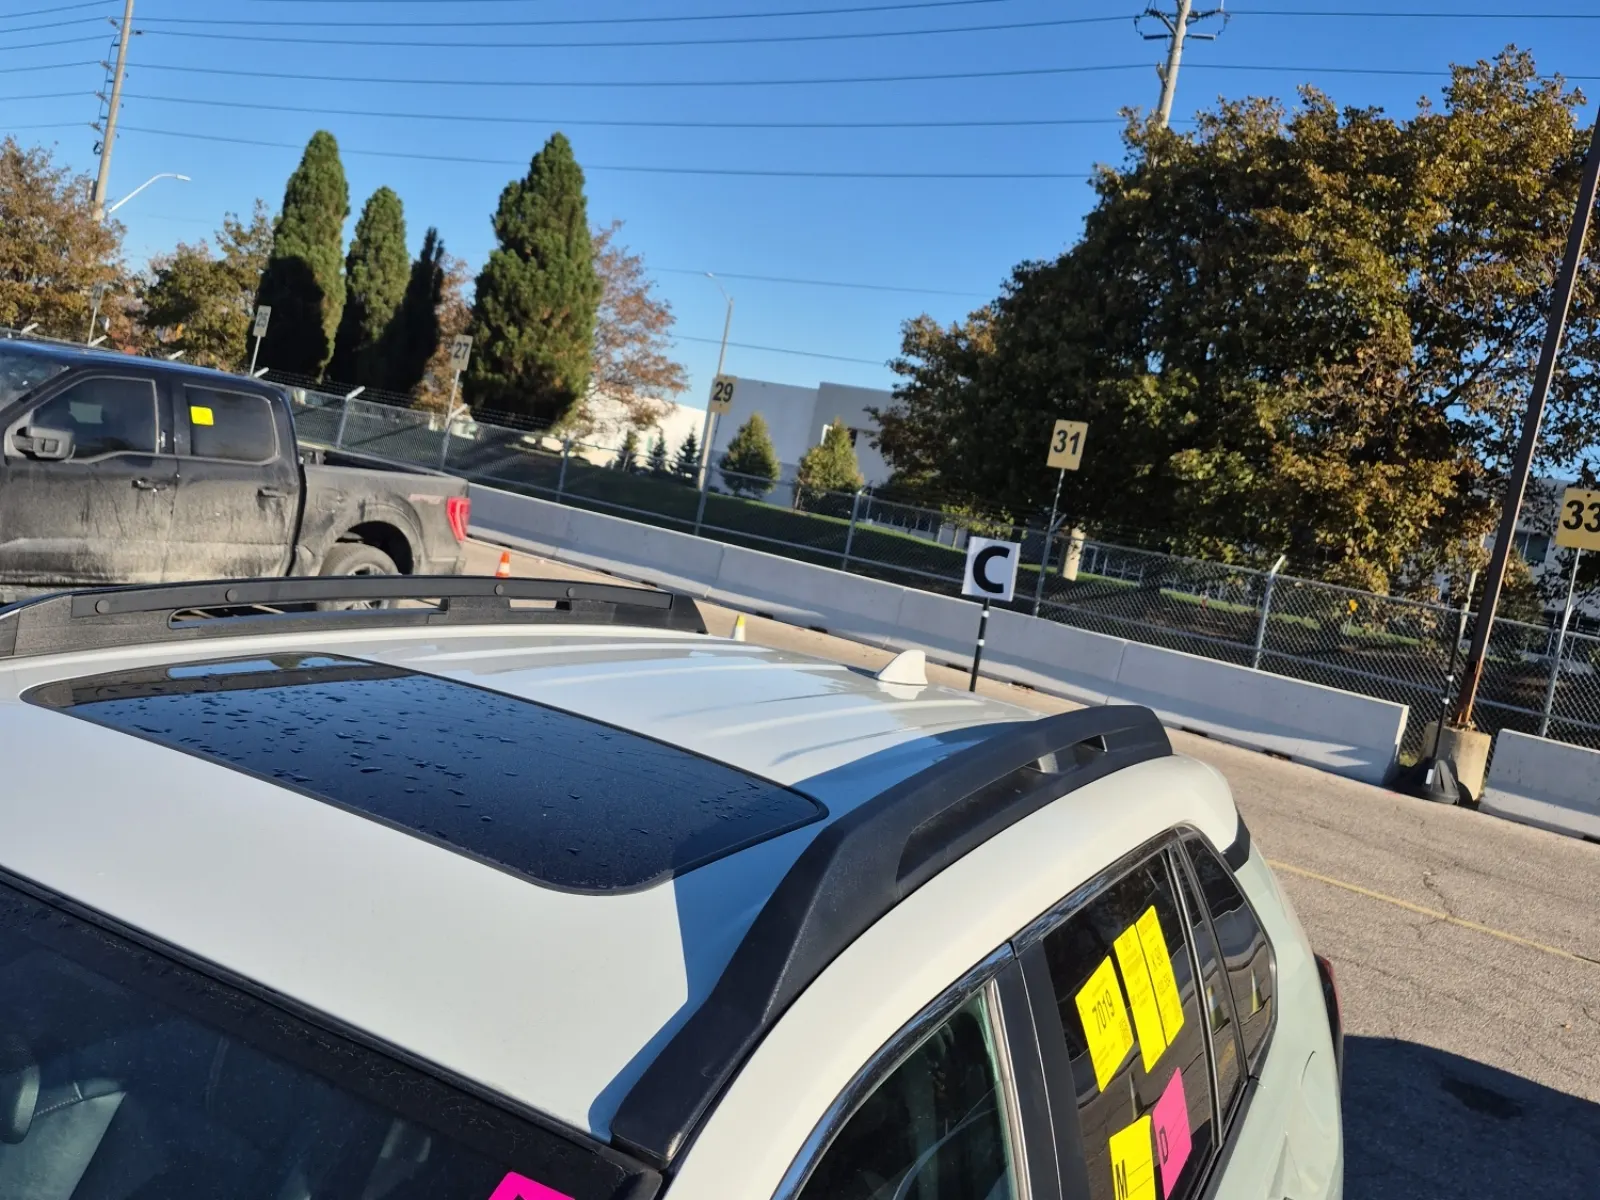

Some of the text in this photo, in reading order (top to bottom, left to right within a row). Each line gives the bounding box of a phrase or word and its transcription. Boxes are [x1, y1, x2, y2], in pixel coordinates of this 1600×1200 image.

[453, 341, 470, 360] 27
[712, 381, 734, 403] 29
[1053, 429, 1081, 455] 31
[1562, 500, 1600, 533] 33
[972, 545, 1010, 594] C
[1091, 989, 1116, 1036] 7019
[1158, 1125, 1169, 1166] D
[1115, 1159, 1129, 1200] M
